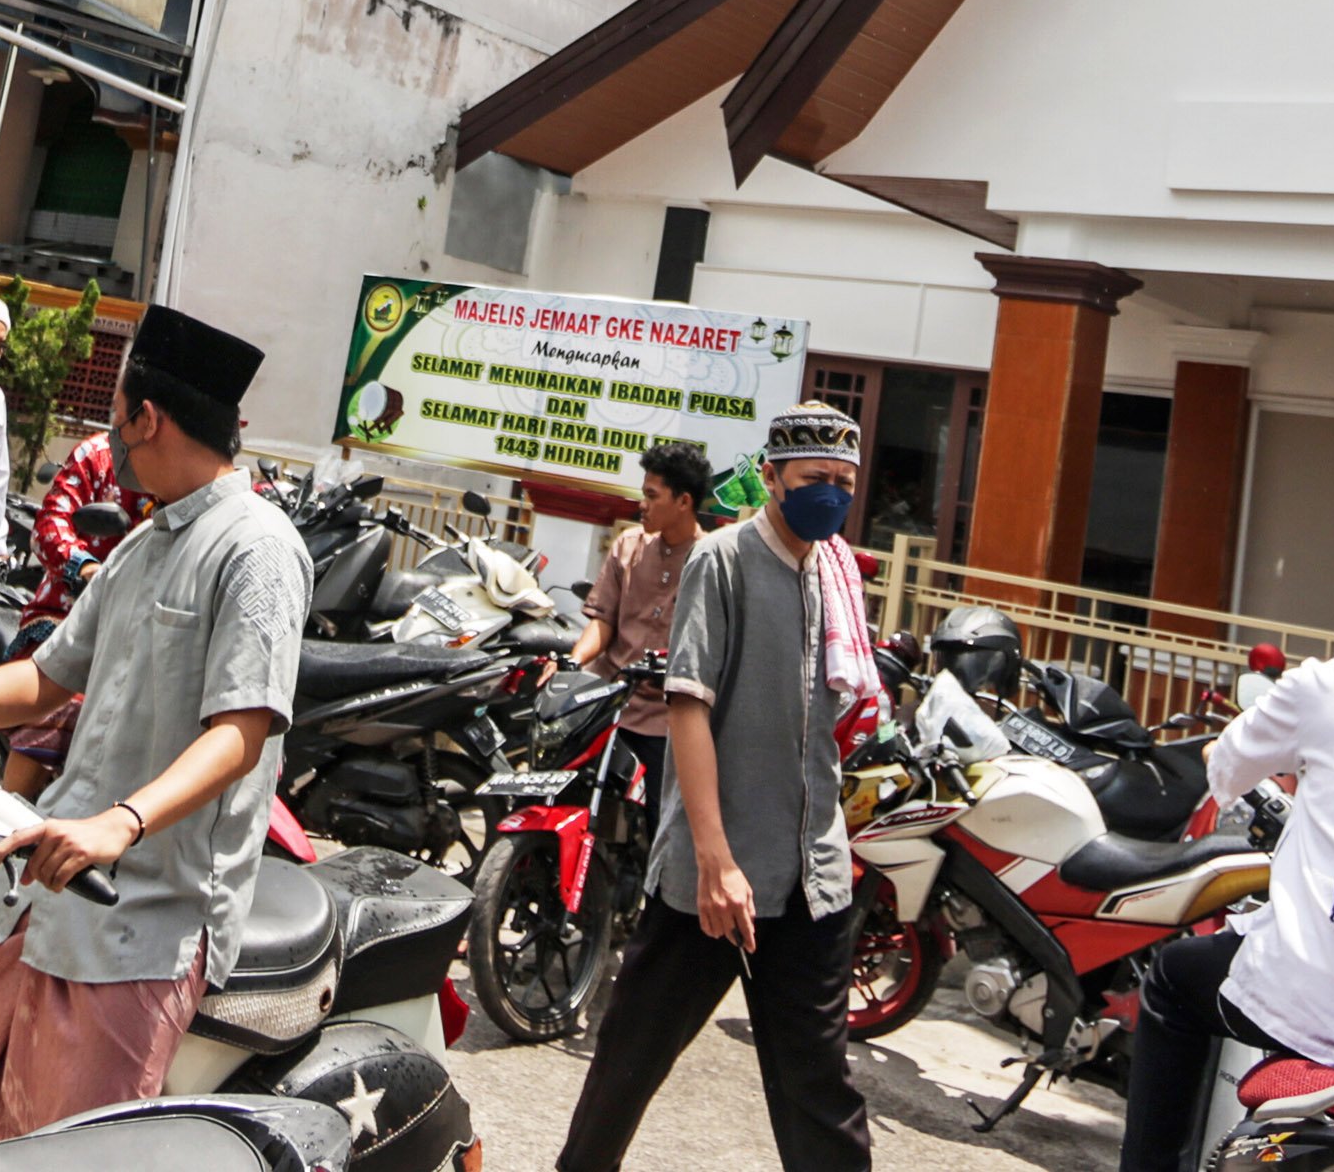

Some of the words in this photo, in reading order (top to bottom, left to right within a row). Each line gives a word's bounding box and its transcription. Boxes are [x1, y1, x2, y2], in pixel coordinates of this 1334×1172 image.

[454, 299, 525, 327] MAJELIS
[529, 308, 601, 336] JEMAAT
[605, 316, 645, 342] GKE
[650, 321, 742, 353] NAZARET
[531, 340, 641, 370] Mengucapkan
[412, 354, 483, 379] SELAMAT
[489, 364, 603, 397] MENUNAIKAN
[609, 381, 682, 409] IBADAH
[688, 392, 755, 419] PUASA
[546, 397, 587, 419] DAN
[421, 400, 499, 428] SELAMAT
[502, 413, 547, 437] HARI
[550, 421, 598, 445] RAYA
[603, 428, 647, 452] IDUL
[495, 436, 540, 458] 1443
[543, 444, 621, 472] HIJRIAH
